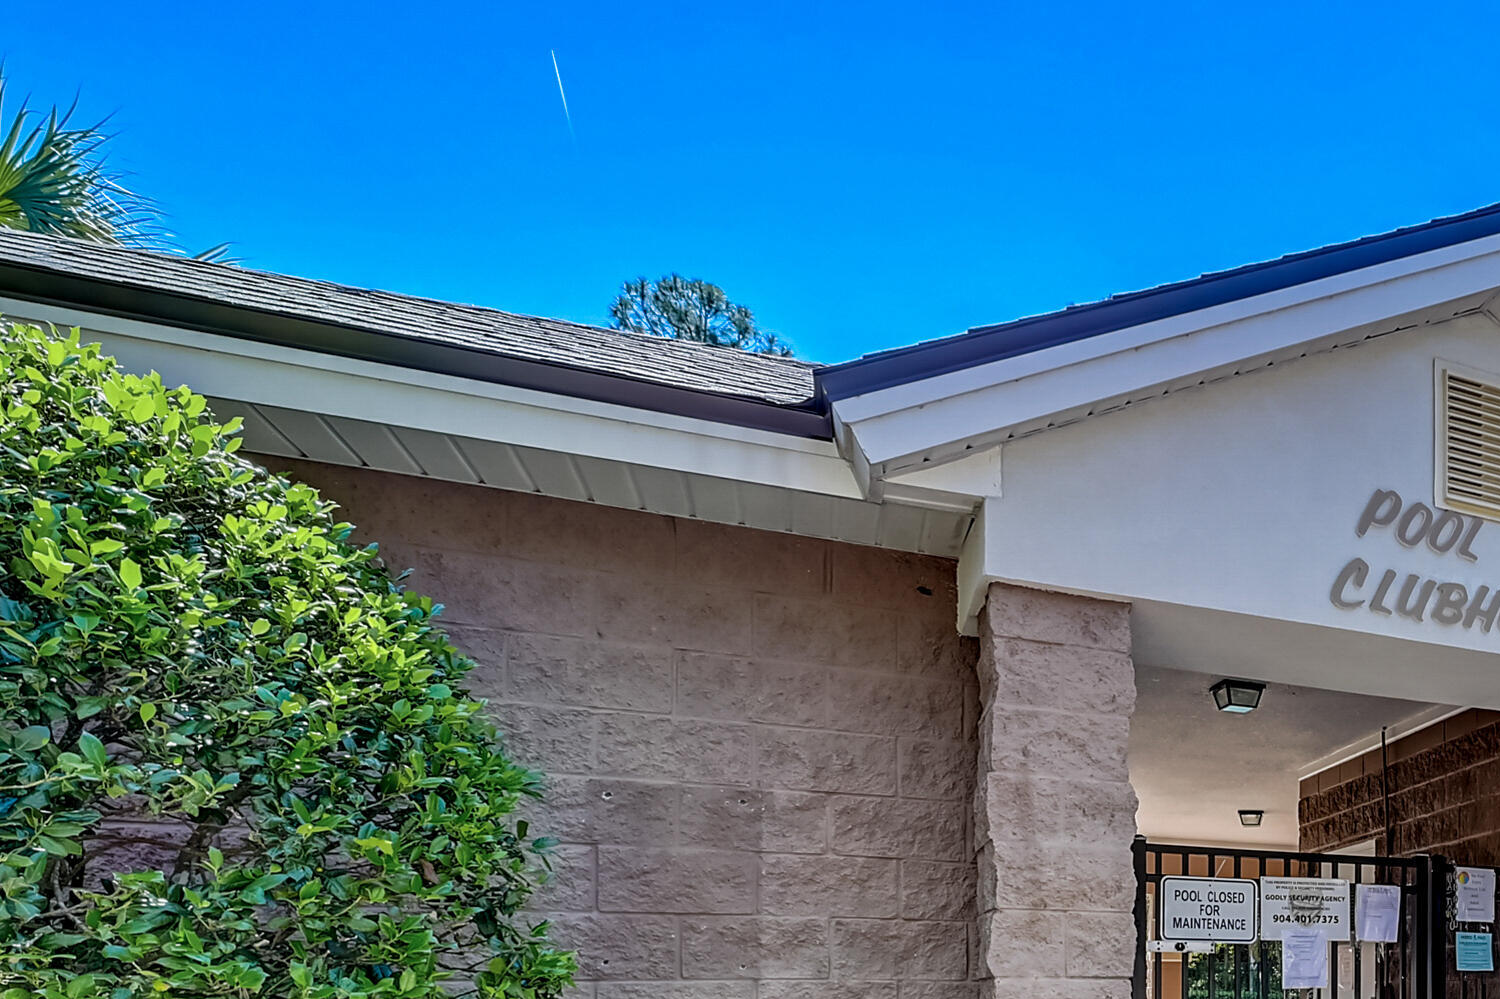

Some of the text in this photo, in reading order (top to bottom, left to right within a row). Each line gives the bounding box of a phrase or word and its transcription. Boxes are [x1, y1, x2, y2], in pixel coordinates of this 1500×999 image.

[1356, 488, 1484, 563] POOL
[1174, 889, 1245, 904] POOL CLOSED
[1199, 904, 1220, 916] FOR
[1172, 917, 1246, 931] MAINTENANCE
[1273, 914, 1339, 924] 904.401.7375
